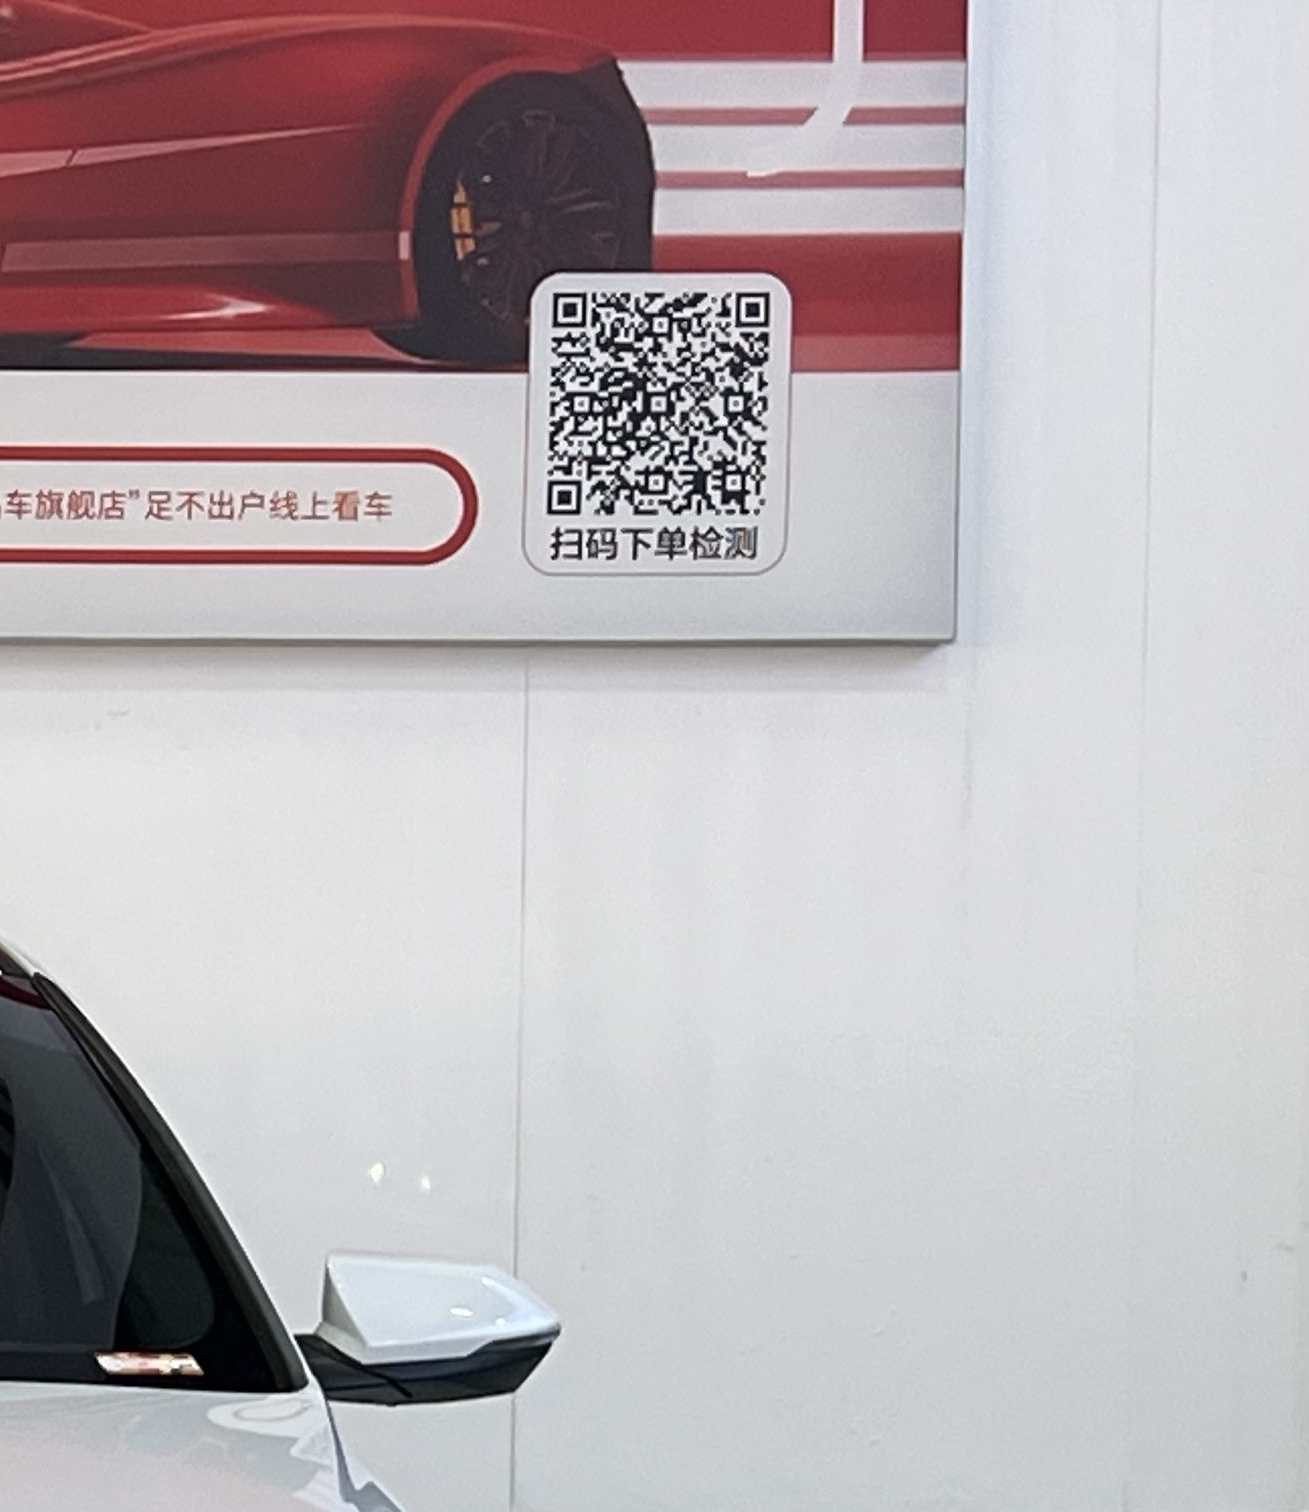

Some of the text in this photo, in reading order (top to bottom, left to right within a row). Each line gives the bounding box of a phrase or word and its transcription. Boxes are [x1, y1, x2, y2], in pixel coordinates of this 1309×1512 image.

[549, 526, 759, 561] 扫码下单检测
